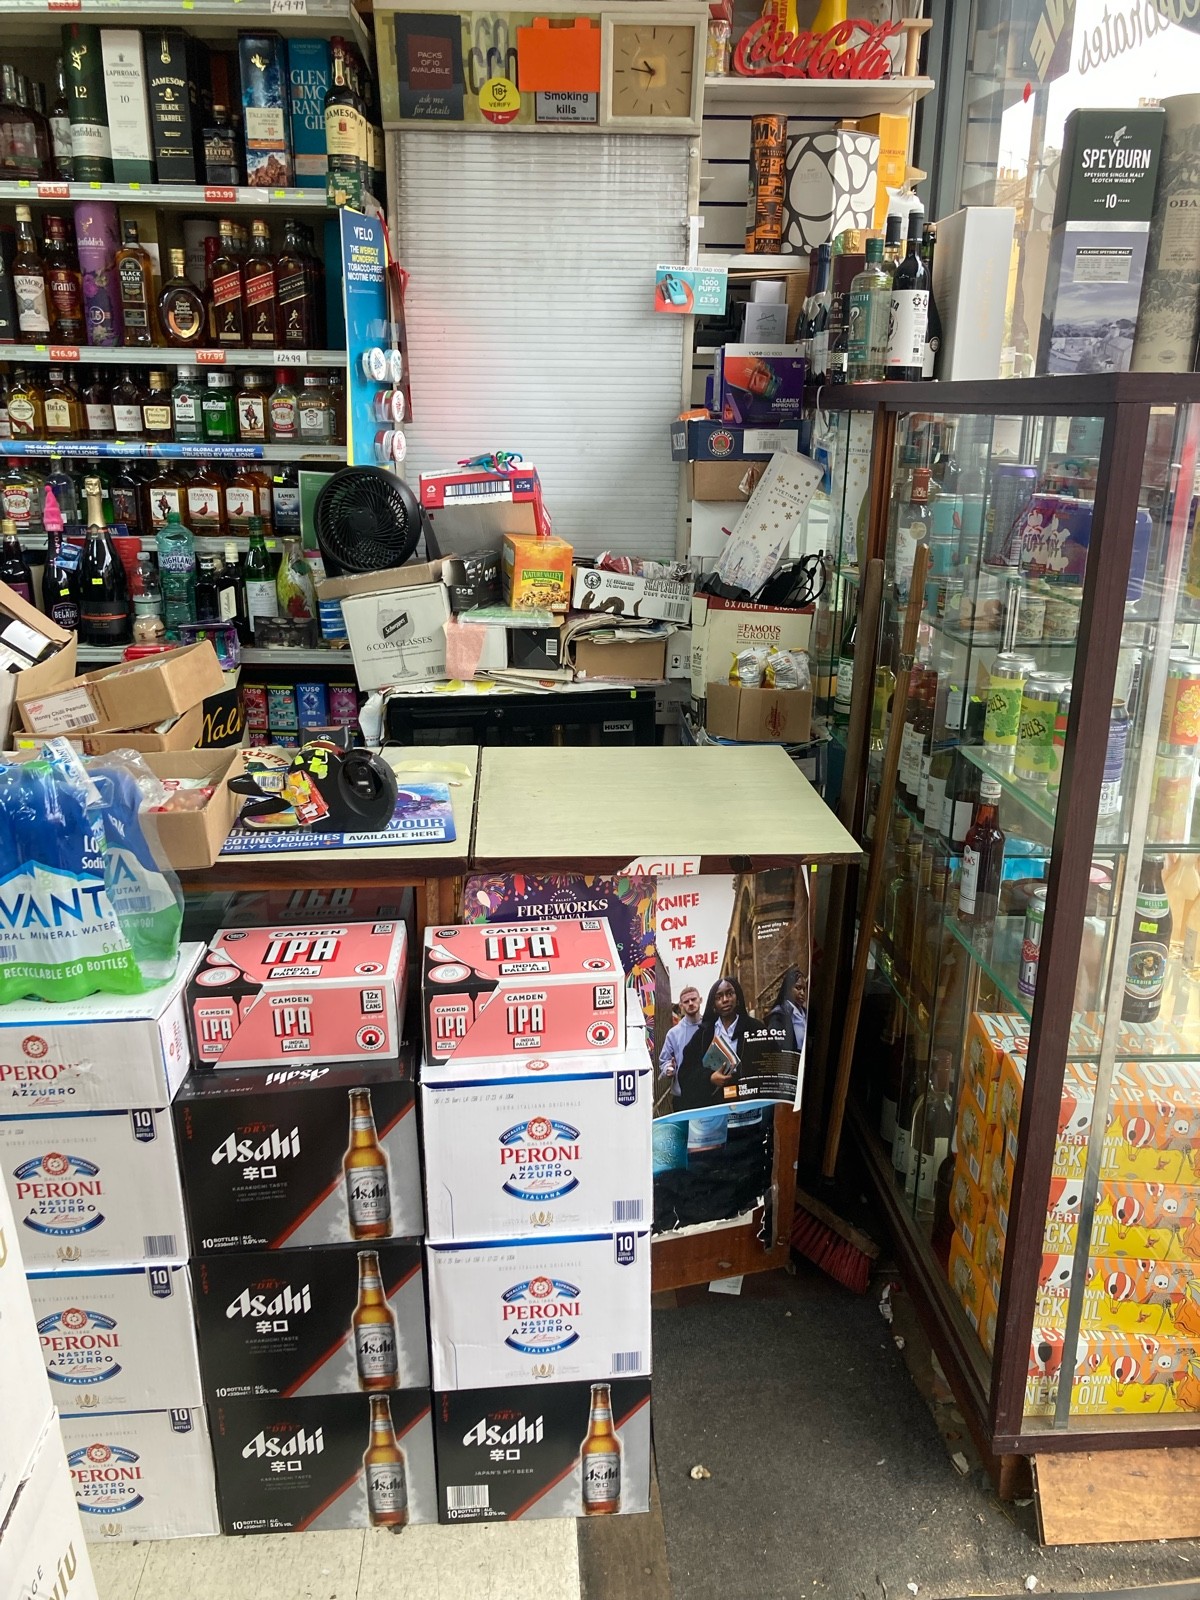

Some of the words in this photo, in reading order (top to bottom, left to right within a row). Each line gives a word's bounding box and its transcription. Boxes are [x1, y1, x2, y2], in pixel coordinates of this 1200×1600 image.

[417, 51, 442, 59] PACKS
[411, 67, 450, 75] AVAILABLE
[151, 77, 186, 88] JAMESON
[291, 70, 327, 85] GLEN
[74, 86, 87, 99] 12
[494, 87, 508, 96] 18+
[544, 92, 589, 103] Smoking
[120, 95, 130, 104] 10
[419, 94, 431, 104] ask
[292, 101, 320, 115] RAN
[325, 107, 358, 121] JAMESON
[412, 105, 425, 116] for
[426, 104, 450, 115] details
[556, 104, 577, 114] kills
[160, 114, 183, 122] BARREL
[1082, 148, 1151, 169] SPEYBURN
[206, 190, 233, 199] £33.99
[1105, 194, 1117, 209] 10
[354, 226, 374, 241] VELO
[350, 244, 359, 253] THE
[359, 246, 379, 256] WEIRDLY
[351, 254, 380, 265] WONDERFUL
[348, 262, 383, 274] TOBACCO-FREE
[347, 272, 368, 281] NICOTINE
[214, 286, 224, 294] RED
[224, 280, 240, 290] LABEL
[247, 285, 257, 294] RED
[257, 280, 274, 289] LABEL
[698, 285, 721, 293] PUFFS
[197, 352, 225, 360] £17.99
[161, 556, 193, 566] HIGHLAND
[523, 571, 543, 581] NATURE
[544, 572, 564, 582] VALLEY
[455, 587, 474, 596] OCB
[744, 624, 781, 633] FAMOUS
[743, 632, 781, 640] GROUSE
[366, 643, 372, 652] 6
[372, 641, 396, 651] COPA
[396, 635, 433, 648] GLASSES
[34, 713, 51, 722] Honey
[51, 708, 65, 717] Chilli
[65, 703, 87, 713] Peanuts
[604, 722, 632, 731] HUSKY
[278, 833, 341, 844] POUCHES
[348, 831, 407, 842] AVAILABLE
[410, 829, 440, 839] HERE
[83, 835, 100, 854] LO
[259, 841, 320, 850] SWEDISH
[516, 898, 609, 918] FIREWORKS
[655, 892, 700, 913] KNIFE
[1144, 900, 1164, 908] HELLES
[660, 915, 688, 932] ON
[30, 929, 78, 941] MINERAL
[81, 920, 116, 935] WATER
[274, 929, 342, 938] CAMDEN
[485, 926, 551, 934] CAMDEN
[485, 934, 560, 961] IPA
[669, 934, 696, 951] THE
[262, 937, 342, 964] IPA
[675, 950, 719, 971] TABLE
[4, 965, 63, 980] RECYCLABLE
[65, 964, 84, 979] ECO
[87, 956, 129, 971] BOTTLES
[365, 991, 380, 1000] 12x
[598, 988, 611, 996] 12x
[272, 996, 310, 1005] CAMDEN
[365, 1002, 382, 1010] CANS
[597, 998, 613, 1006] CANS
[273, 1007, 314, 1037] IPA
[506, 1004, 546, 1035] IPA
[202, 1018, 233, 1041] IPA
[436, 1015, 467, 1038] IPA
[743, 1031, 750, 1039] 5
[756, 1029, 768, 1037] 26
[770, 1028, 786, 1036] Oct
[265, 1067, 330, 1086] Asahi
[618, 1075, 634, 1091] 10
[12, 1087, 76, 1097] AZZURRO
[738, 1088, 758, 1096] COCKPIT
[136, 1111, 151, 1127] 10
[211, 1126, 301, 1166] Asahi
[500, 1145, 580, 1165] PERONI
[519, 1163, 562, 1171] NASTRO
[242, 1166, 277, 1181] 辛口
[509, 1169, 572, 1180] AZZURRO
[16, 1180, 103, 1200] PERONI
[351, 1185, 388, 1201] Asahi
[521, 1191, 561, 1200] ITALIANA
[38, 1198, 84, 1207] NASTRO
[29, 1204, 96, 1215] AZZURRO
[44, 1226, 86, 1235] ITALIANA
[617, 1236, 633, 1252] 10
[152, 1270, 167, 1284] 10
[225, 1283, 312, 1319] Asahi
[502, 1302, 581, 1321] PERONI
[255, 1320, 289, 1334] 辛口
[521, 1319, 562, 1327] NASTRO
[359, 1340, 393, 1354] Asahi
[57, 1350, 101, 1358] NASTRO
[49, 1355, 114, 1366] AZZURRO
[64, 1375, 104, 1384] ITALIANA
[1078, 1385, 1108, 1405] OIL
[172, 1409, 188, 1421] 10
[462, 1415, 544, 1446] Asahi
[241, 1427, 325, 1459] Asahi
[489, 1449, 521, 1462] 辛口
[83, 1482, 124, 1490] NASTRO
[369, 1479, 403, 1491] Asahi
[75, 1487, 136, 1497] AZZURRO
[89, 1505, 127, 1513] ITALIANA
